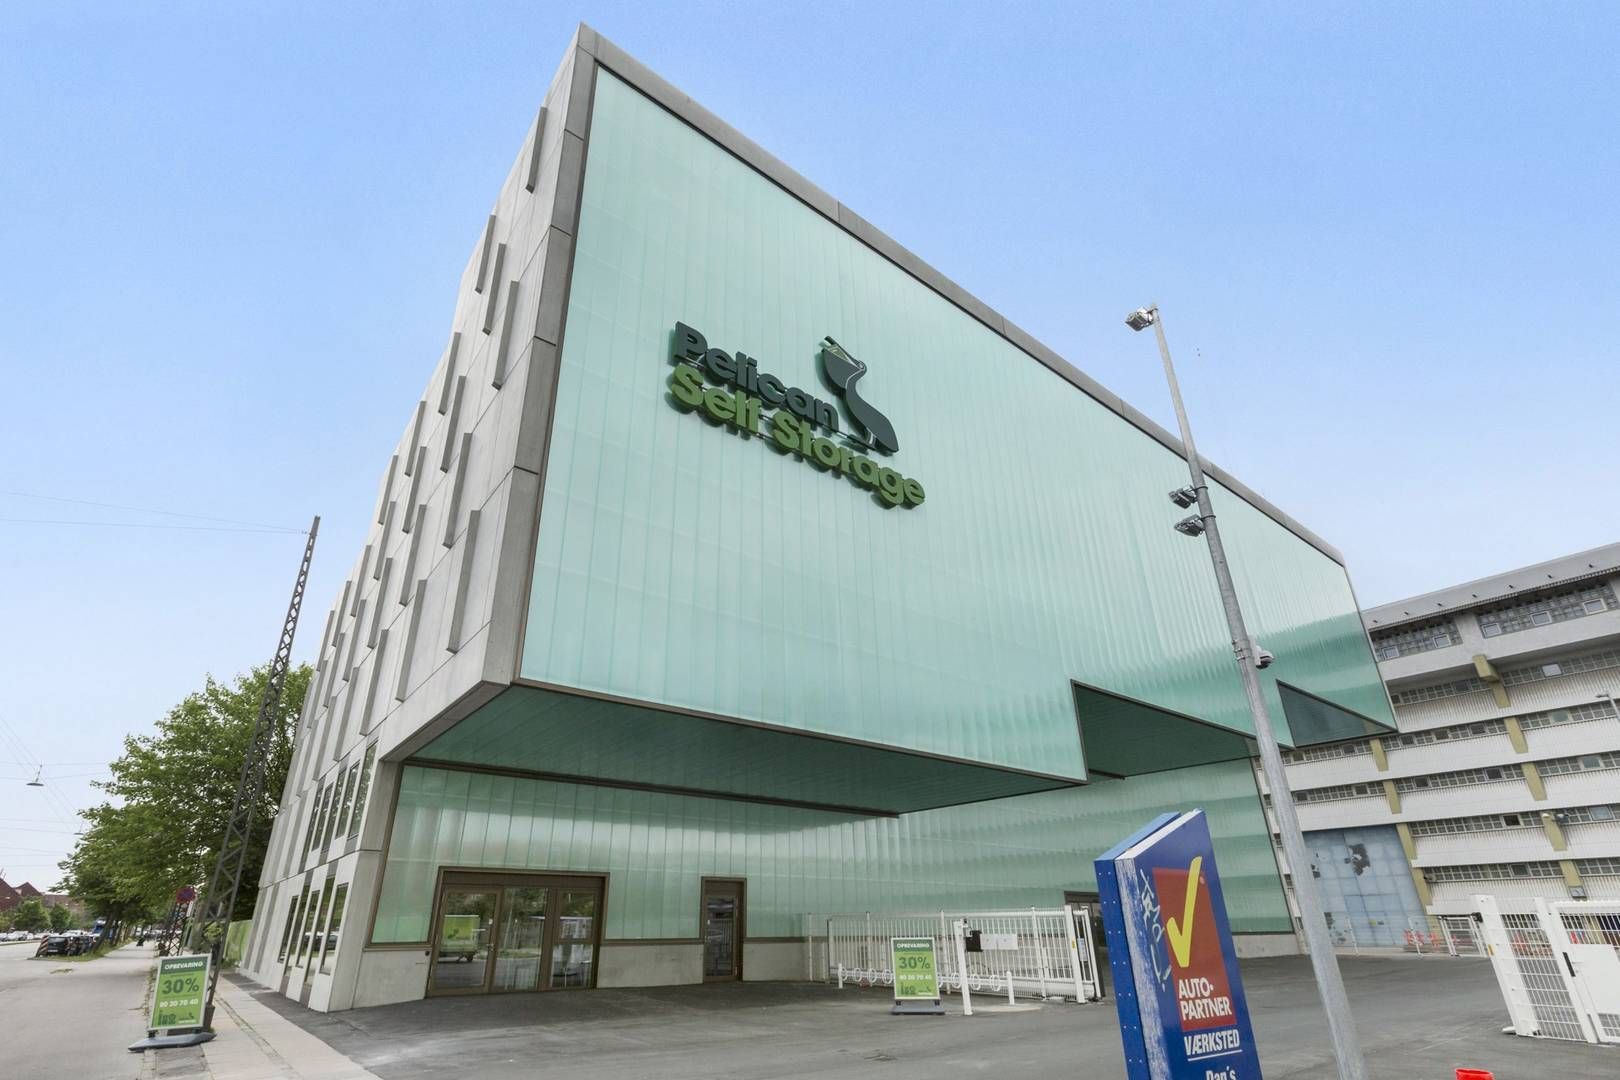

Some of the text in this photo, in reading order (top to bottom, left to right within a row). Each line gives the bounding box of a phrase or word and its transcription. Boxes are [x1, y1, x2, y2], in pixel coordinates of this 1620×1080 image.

[674, 320, 839, 433] Pelican
[671, 362, 926, 508] Self Storage
[899, 956, 930, 969] 30%
[161, 978, 200, 995] 30%
[1180, 996, 1232, 1021] PARTNER
[1184, 1029, 1240, 1056] VÆRKSTED
